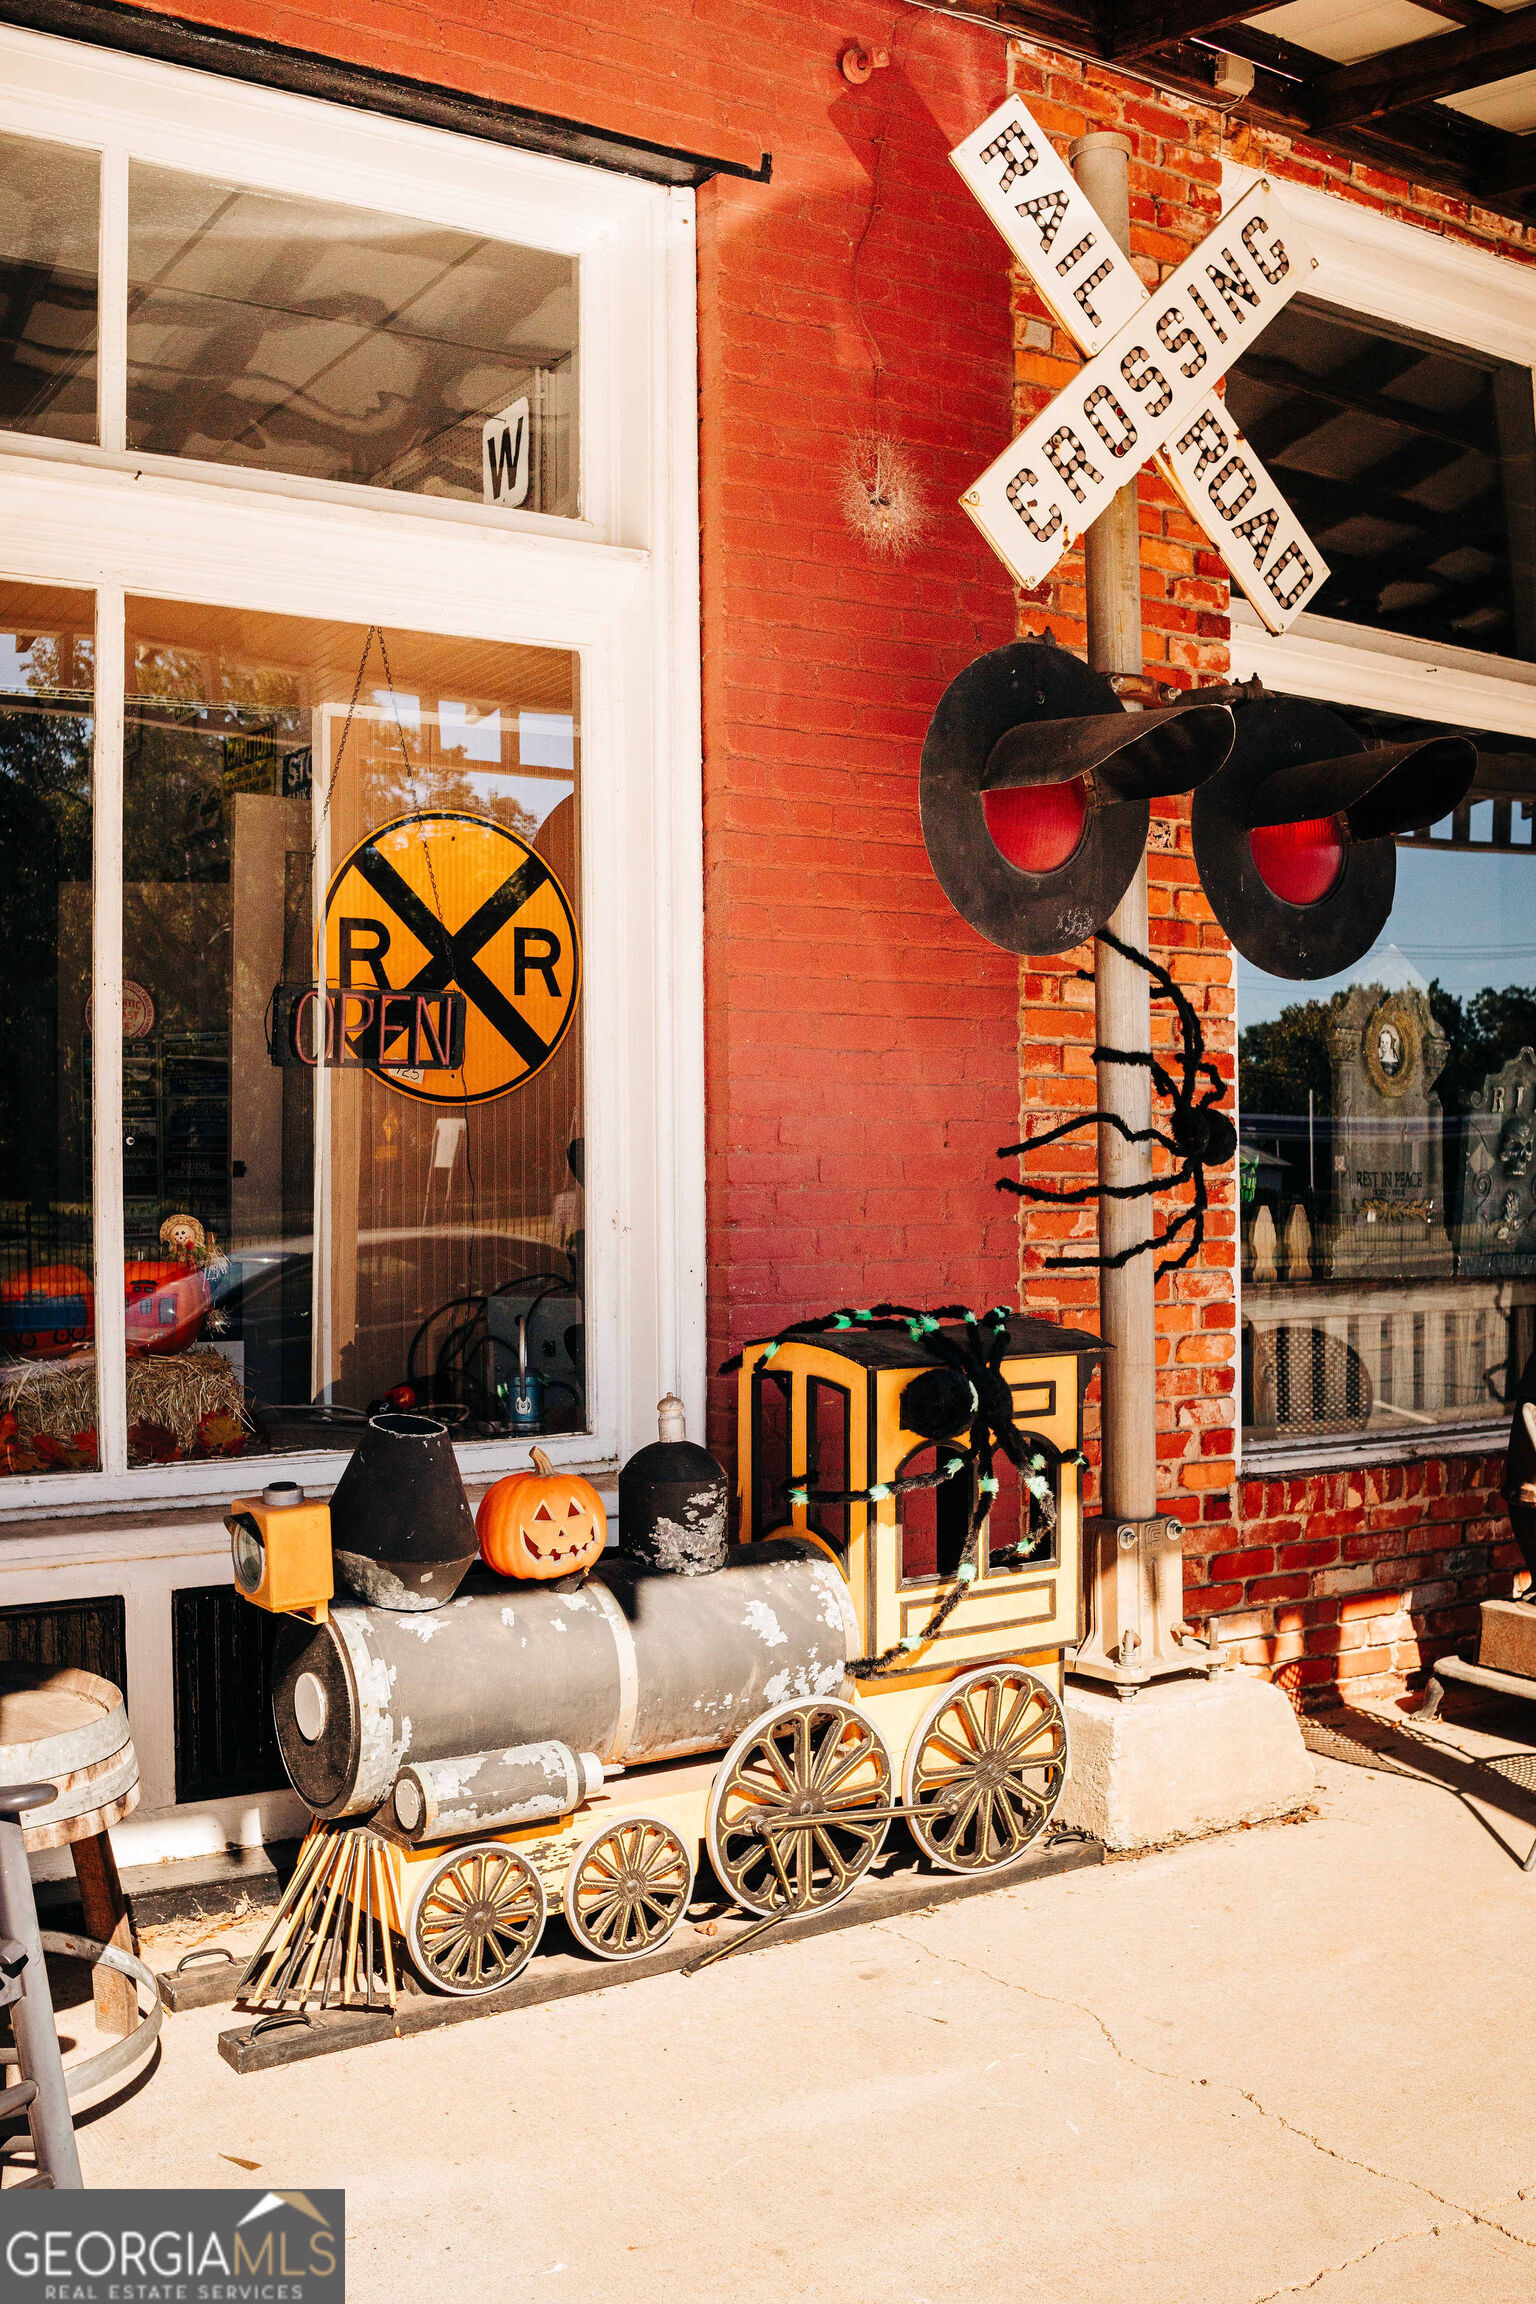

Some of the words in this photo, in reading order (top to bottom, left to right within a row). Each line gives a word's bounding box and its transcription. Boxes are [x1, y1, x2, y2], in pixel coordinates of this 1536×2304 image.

[979, 120, 1114, 329] RAIL
[1005, 215, 1290, 543] CROSSING
[487, 416, 524, 500] W
[1176, 409, 1314, 611] ROAD
[514, 926, 562, 998] R
[296, 990, 452, 1066] OPEN
[1357, 1171, 1378, 1187] REST
[1381, 1171, 1392, 1187] IN
[1394, 1171, 1423, 1187] PEACE
